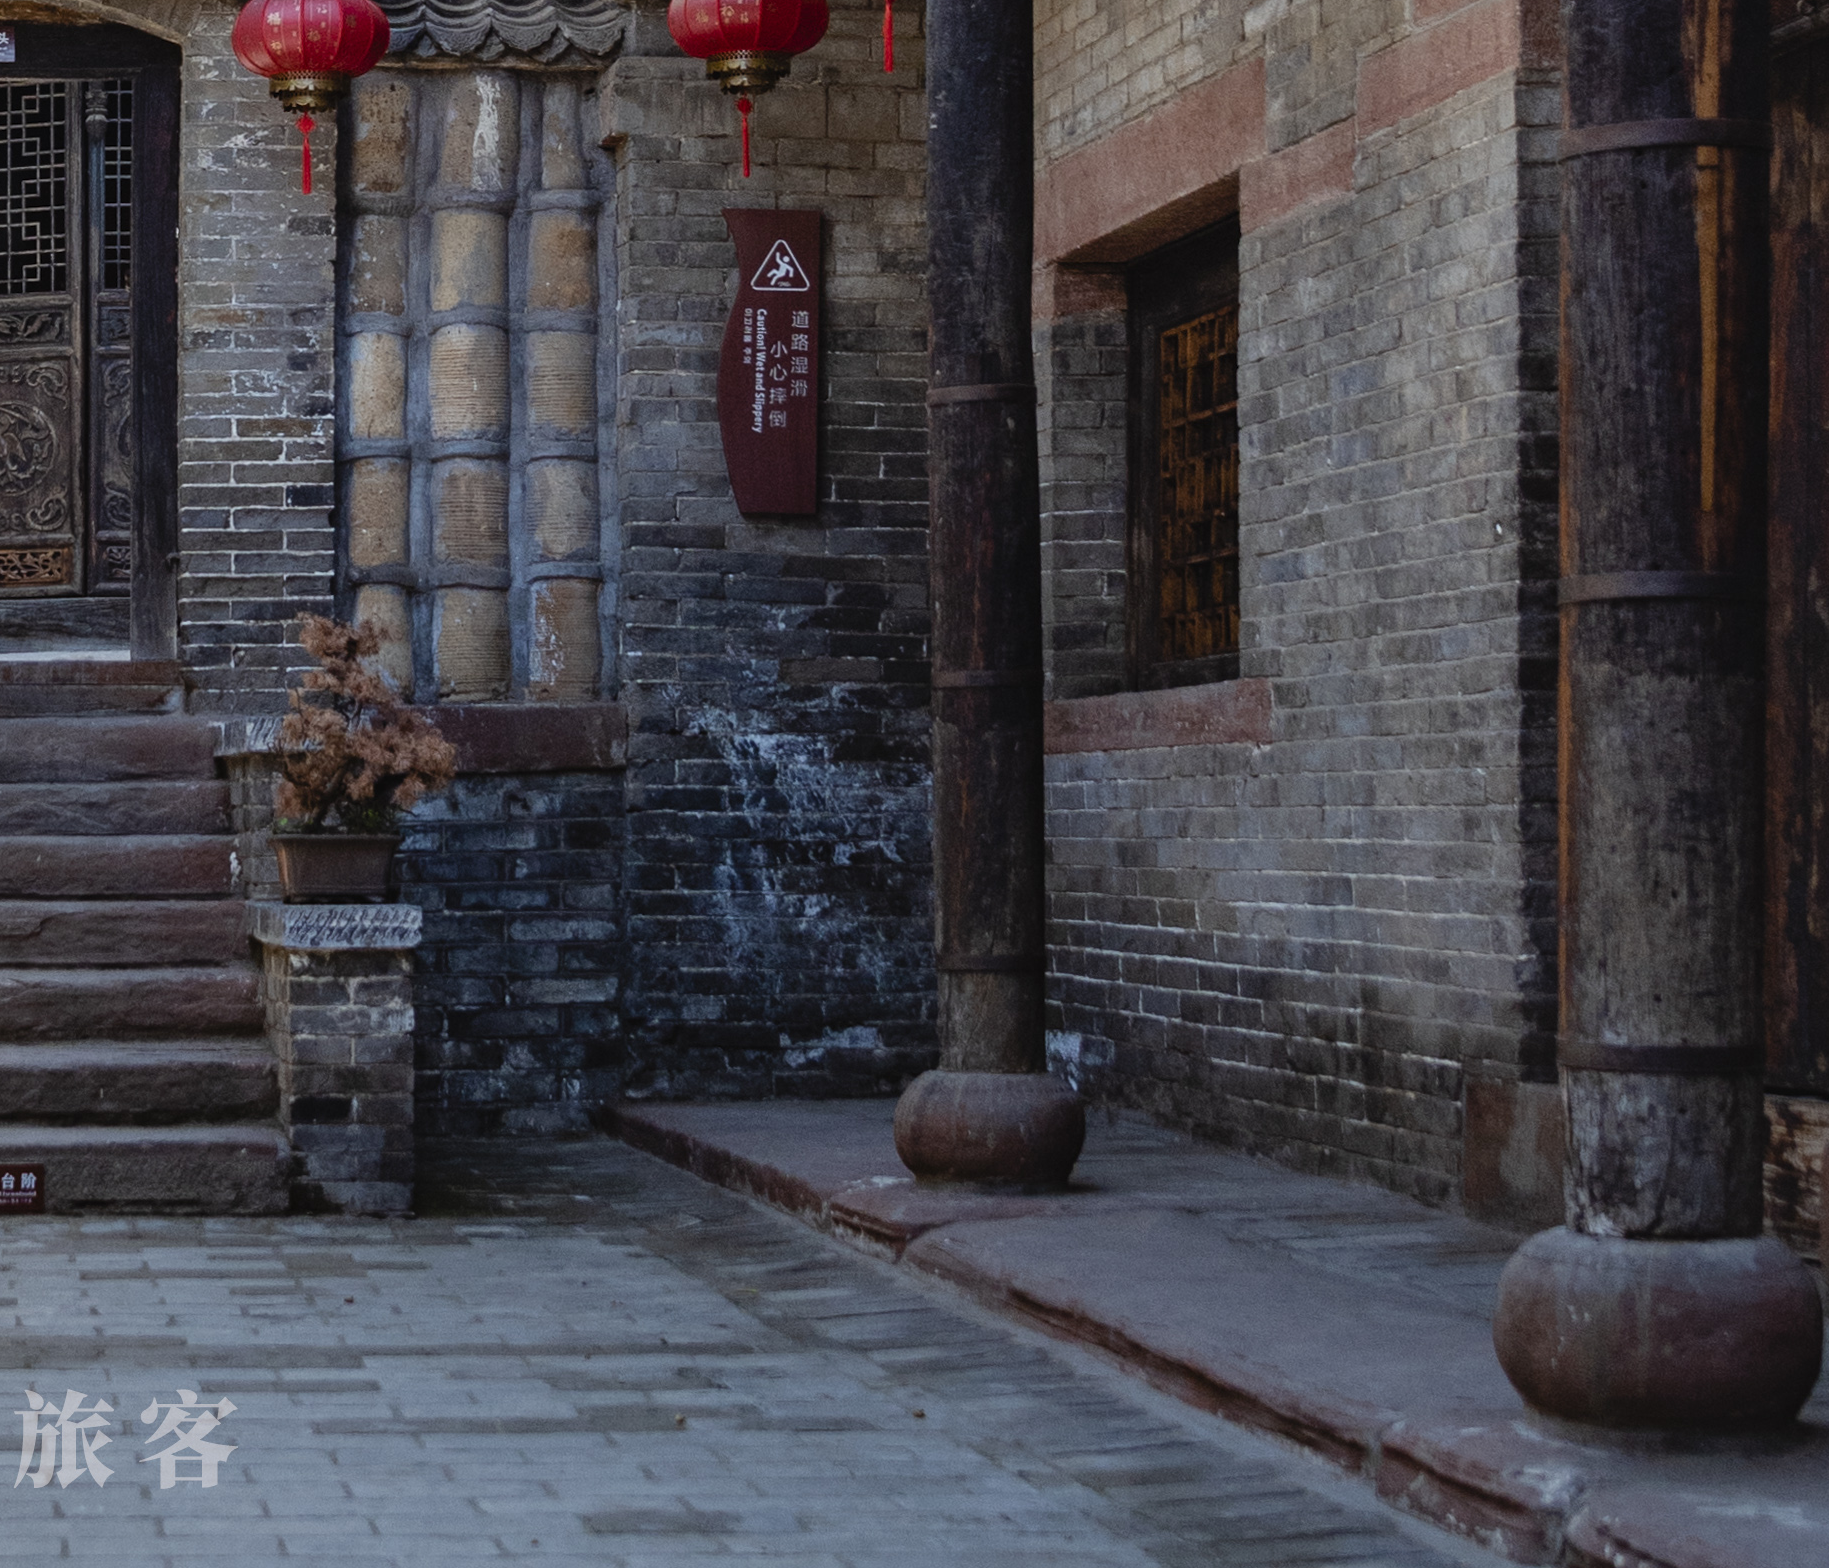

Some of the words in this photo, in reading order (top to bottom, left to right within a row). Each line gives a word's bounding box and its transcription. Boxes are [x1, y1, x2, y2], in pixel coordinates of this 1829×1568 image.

[756, 308, 767, 349] Caution!
[755, 351, 766, 370] Wet
[790, 311, 809, 397] 道路湿滑
[755, 372, 765, 391] and
[769, 340, 788, 427] 小心摔倒
[751, 392, 765, 433] Slippery
